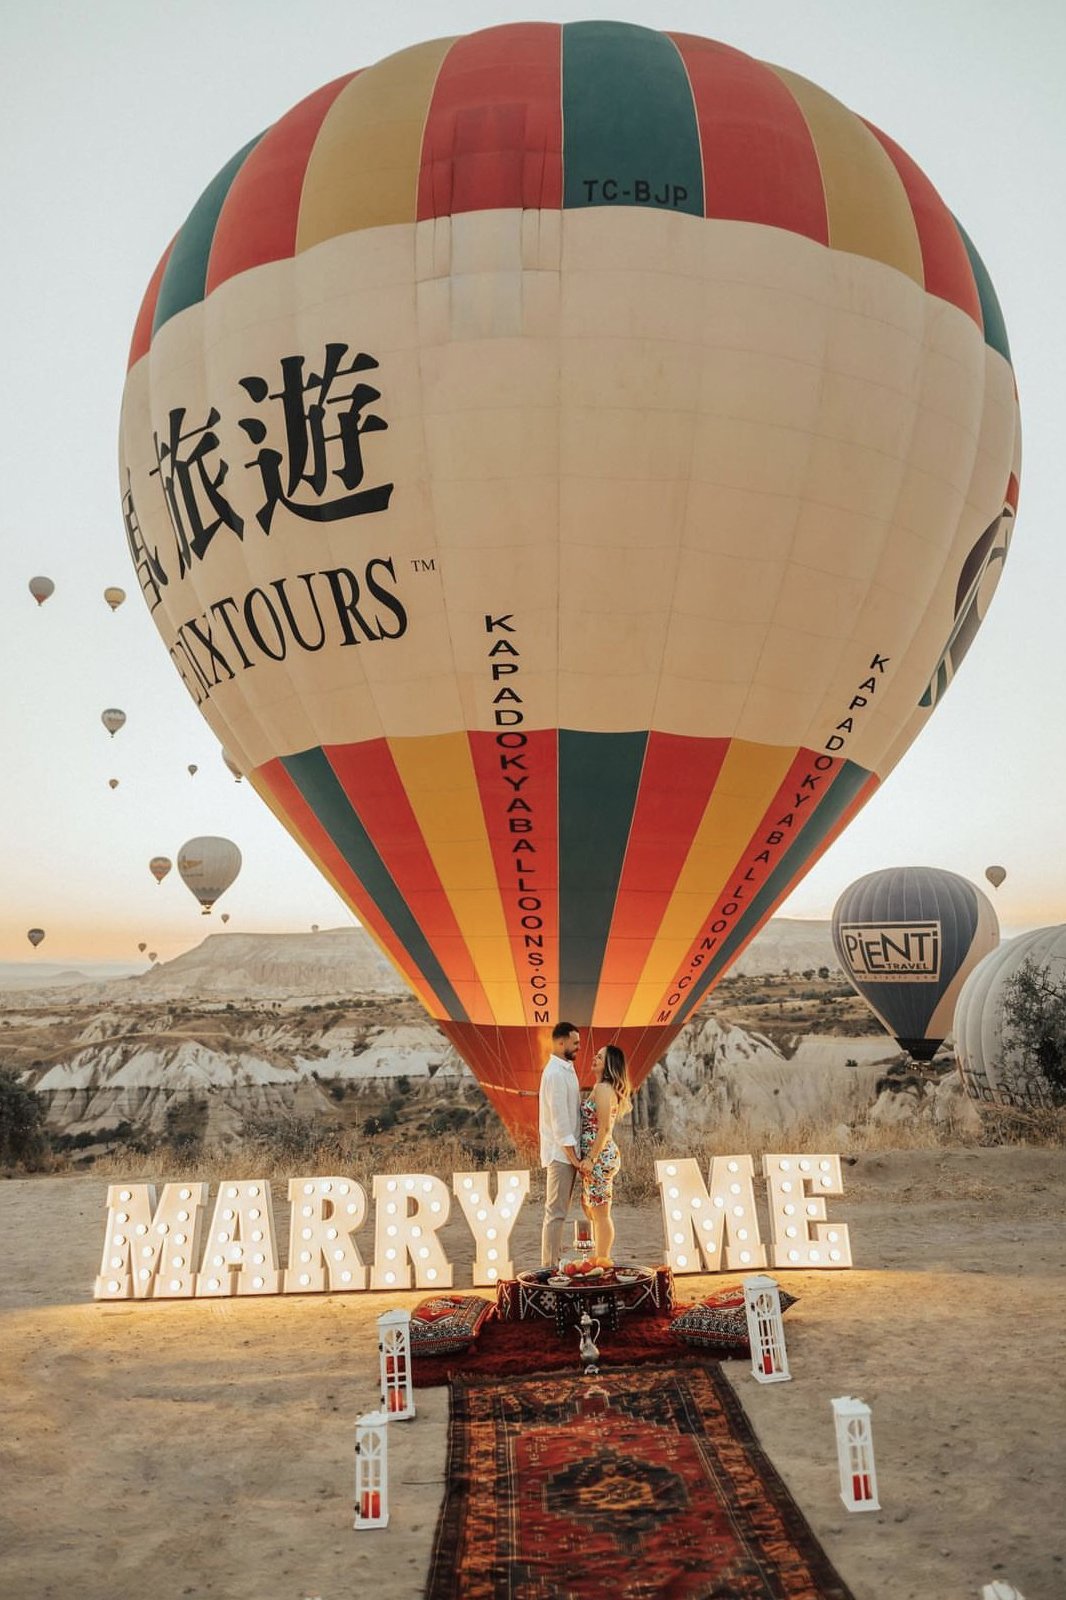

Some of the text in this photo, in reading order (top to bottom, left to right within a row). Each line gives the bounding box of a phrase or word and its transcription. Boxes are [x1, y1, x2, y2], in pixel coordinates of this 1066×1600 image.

[582, 178, 689, 207] TC-BJP
[884, 962, 929, 970] TRAVEL
[93, 1153, 853, 1300] MARRY ME
